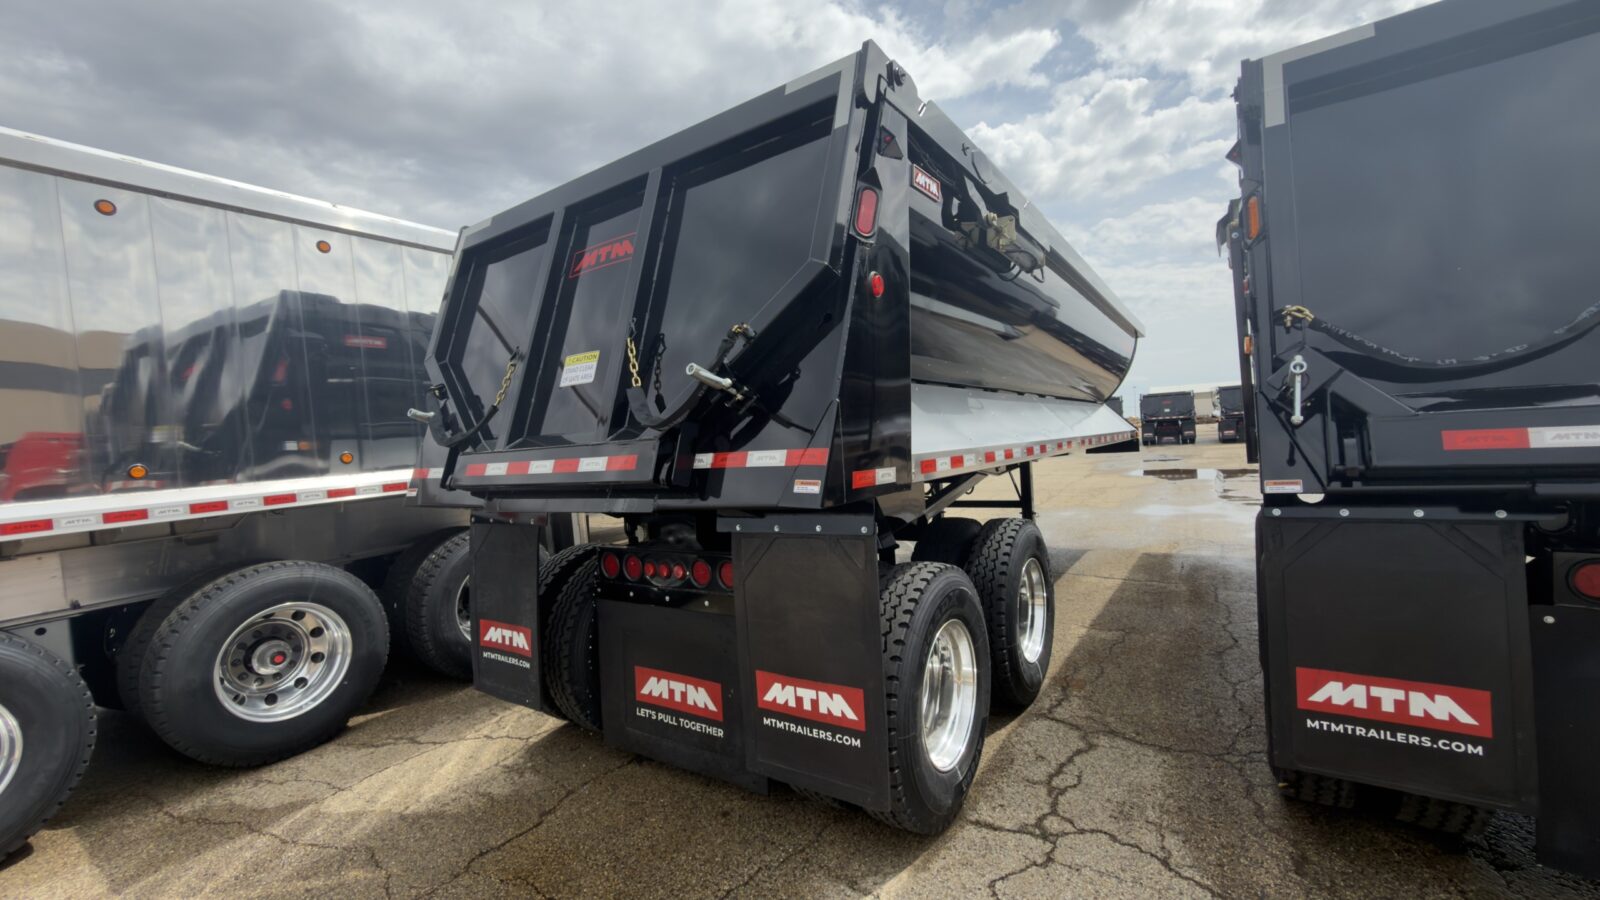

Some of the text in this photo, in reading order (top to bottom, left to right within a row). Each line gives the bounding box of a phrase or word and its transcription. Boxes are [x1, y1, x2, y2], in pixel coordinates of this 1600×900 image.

[916, 172, 939, 196] MTM
[575, 240, 634, 272] MTM
[572, 353, 598, 363] CAUTION
[483, 626, 530, 651] MTM
[483, 651, 530, 669] MTMTRAILERS.COM
[640, 676, 718, 712] MTM
[763, 682, 859, 721] MTM
[1307, 681, 1480, 726] MTM
[636, 707, 724, 738] LET'S PULL TOGETHER
[763, 717, 861, 748] MTMTRAILERS.COM
[1306, 718, 1484, 756] MTMTRAILERS.COM
